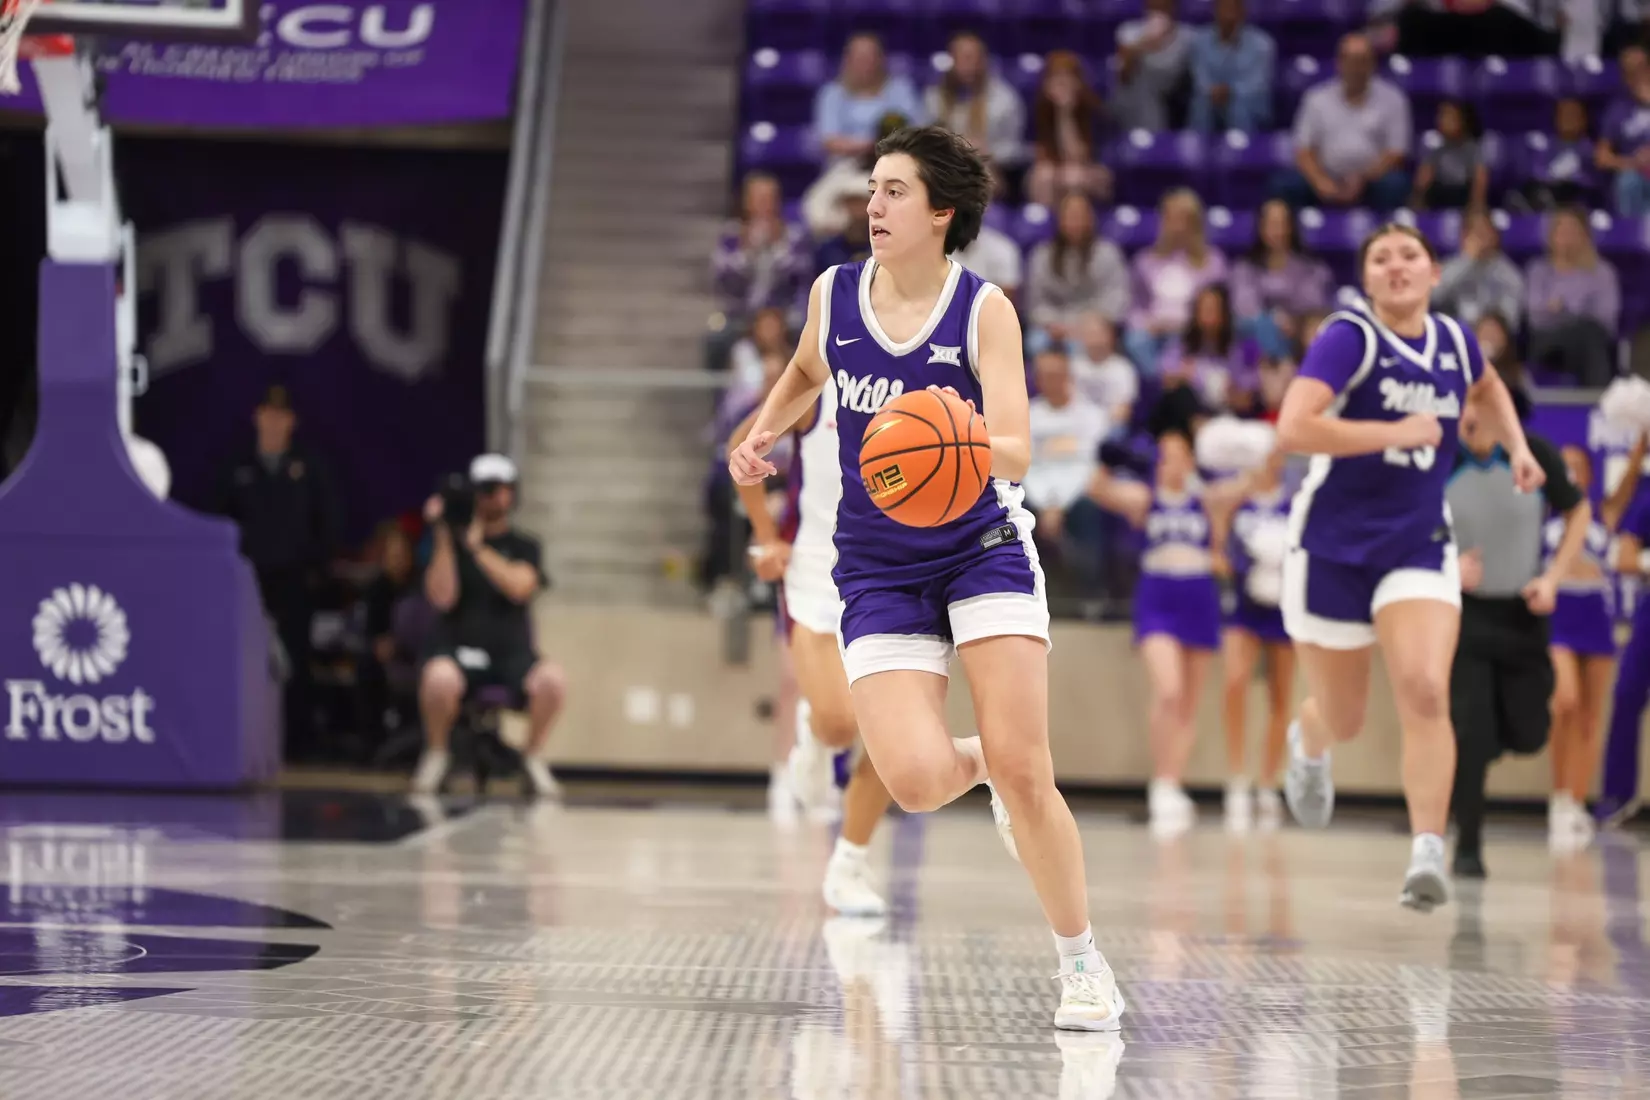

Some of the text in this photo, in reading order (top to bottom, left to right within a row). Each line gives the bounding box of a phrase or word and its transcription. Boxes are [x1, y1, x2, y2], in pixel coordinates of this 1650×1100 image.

[258, 2, 436, 48] CU
[134, 210, 460, 380] TCU
[863, 463, 905, 495] LITE
[4, 678, 156, 744] Frost
